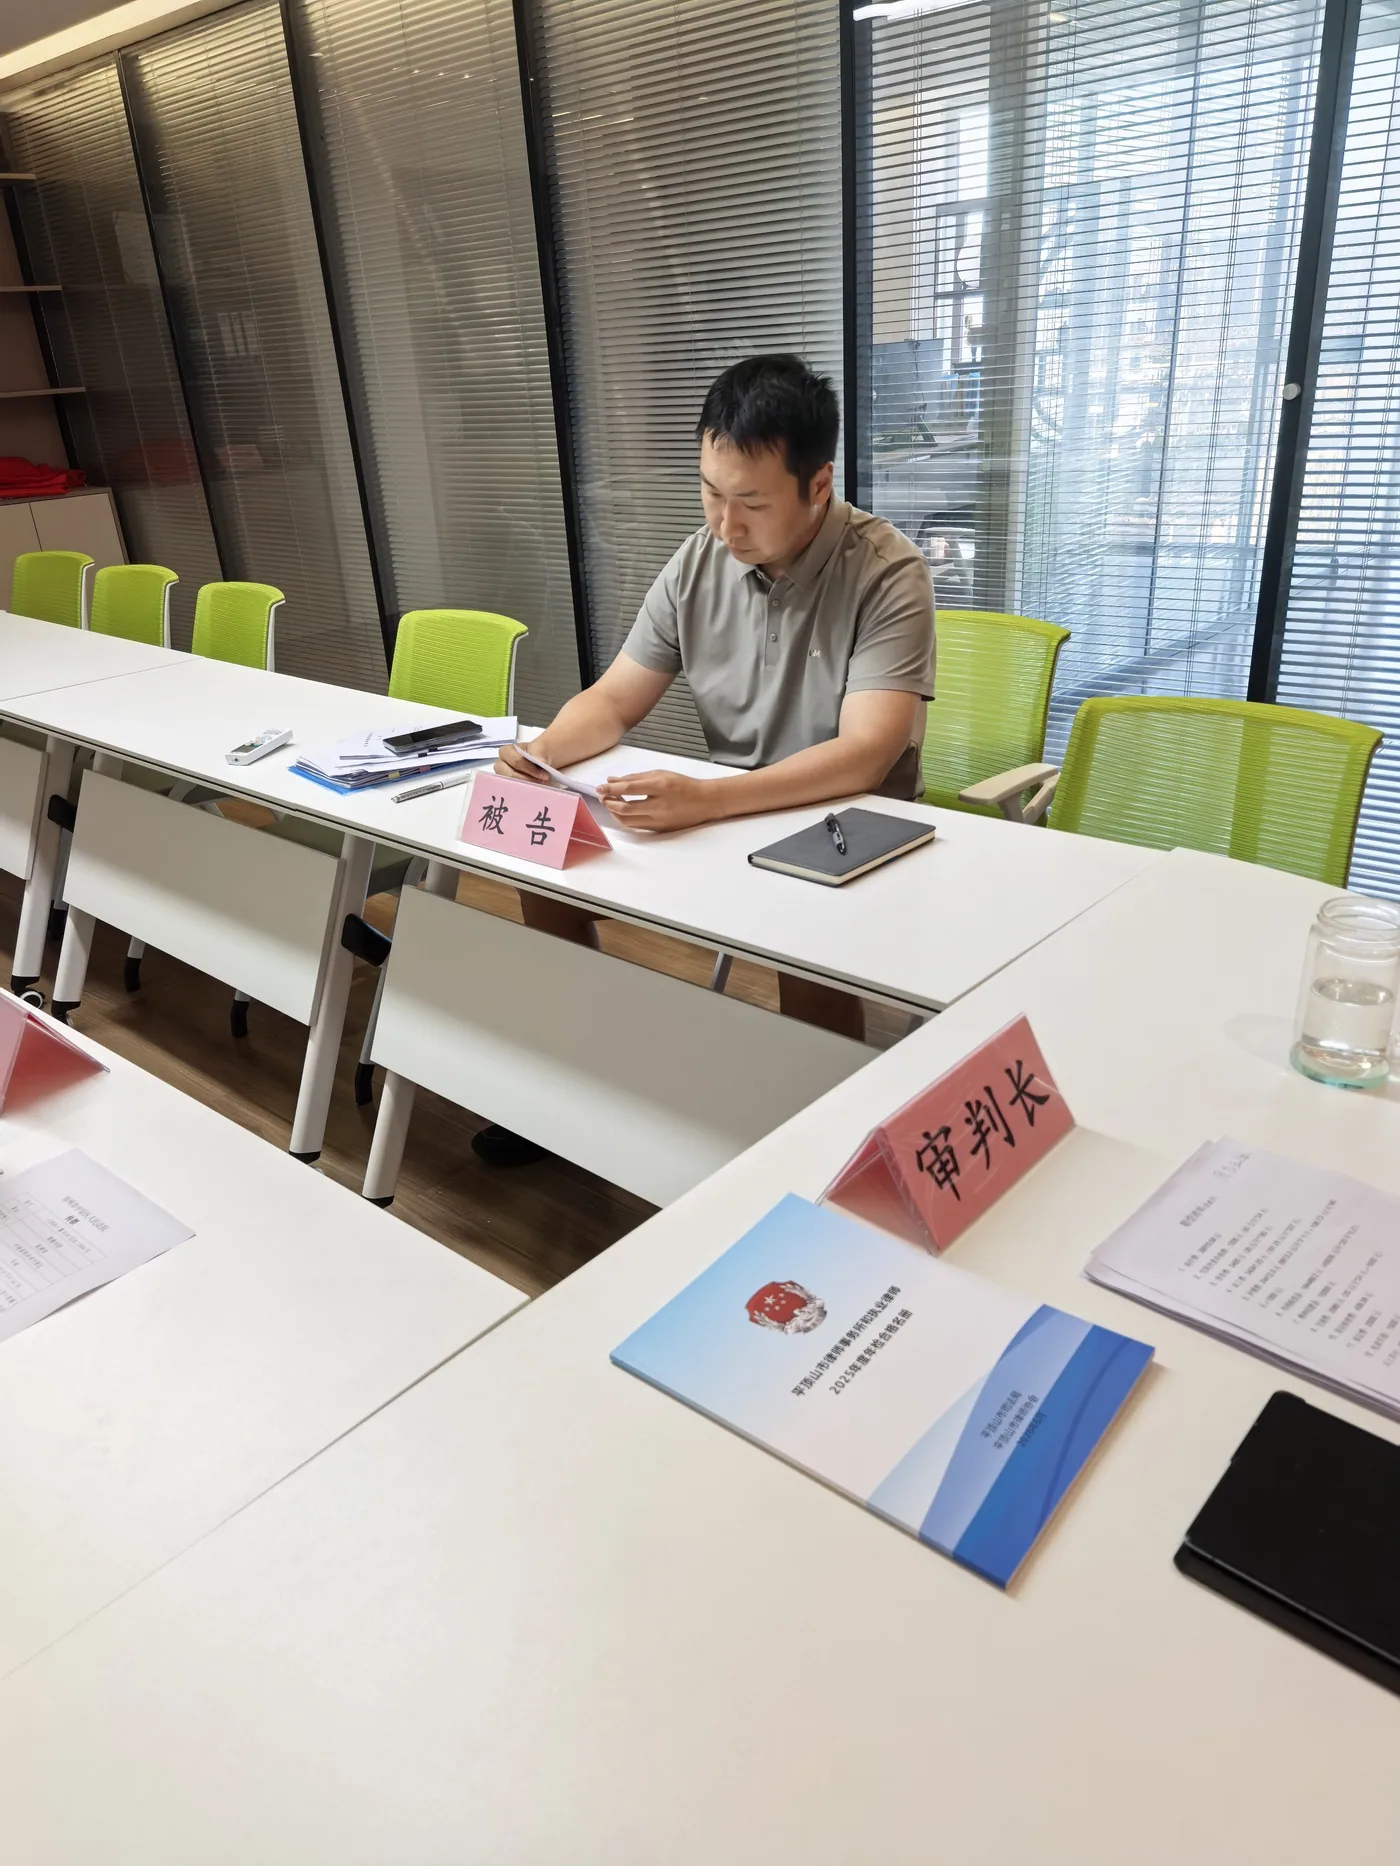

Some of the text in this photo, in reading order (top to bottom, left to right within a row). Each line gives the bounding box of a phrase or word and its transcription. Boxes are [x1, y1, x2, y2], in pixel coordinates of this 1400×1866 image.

[478, 795, 556, 846] 被告
[915, 1059, 1051, 1201] 审判长
[790, 1284, 902, 1399] 平顶山市律师事务所和执业律师
[828, 1308, 914, 1397] 2025年度年检合格名册
